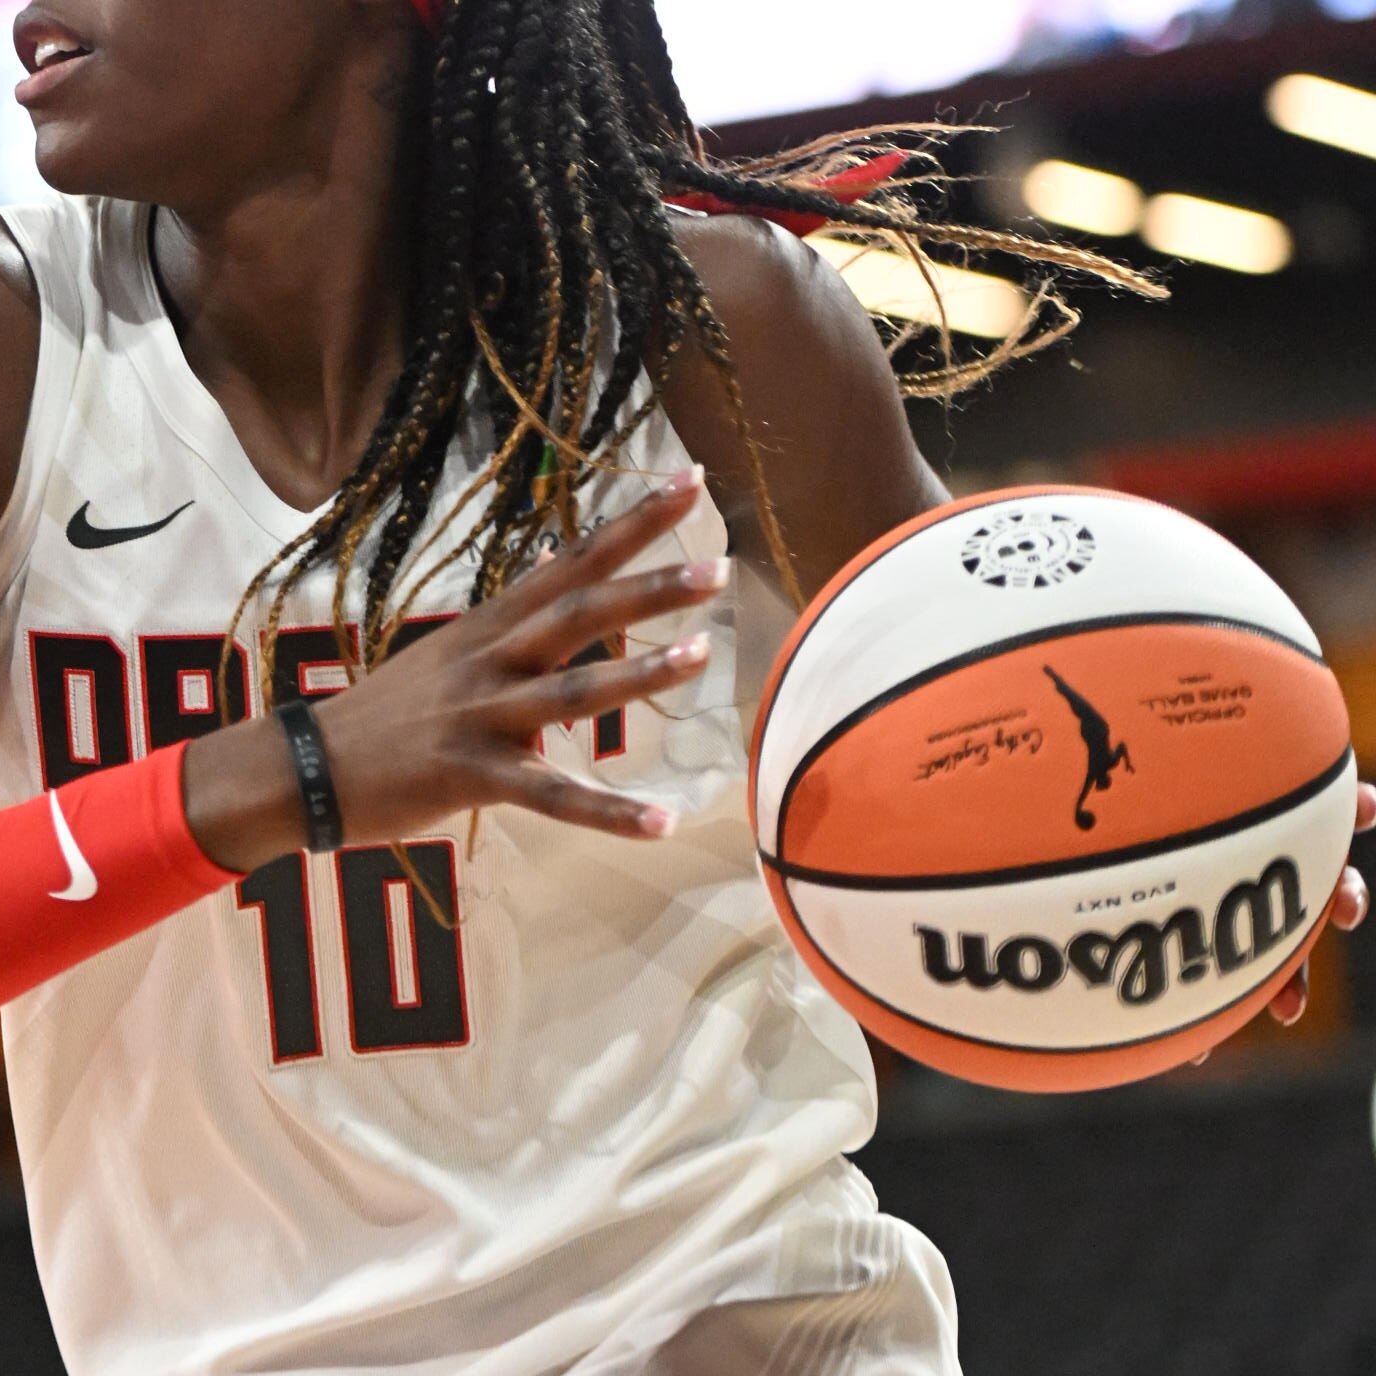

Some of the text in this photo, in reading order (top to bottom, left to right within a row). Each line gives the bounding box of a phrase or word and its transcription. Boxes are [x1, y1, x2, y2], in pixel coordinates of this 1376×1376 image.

[235, 837, 471, 1064] 10
[912, 853, 1310, 1008] Wilson
[1074, 880, 1176, 915] EVO NXT
